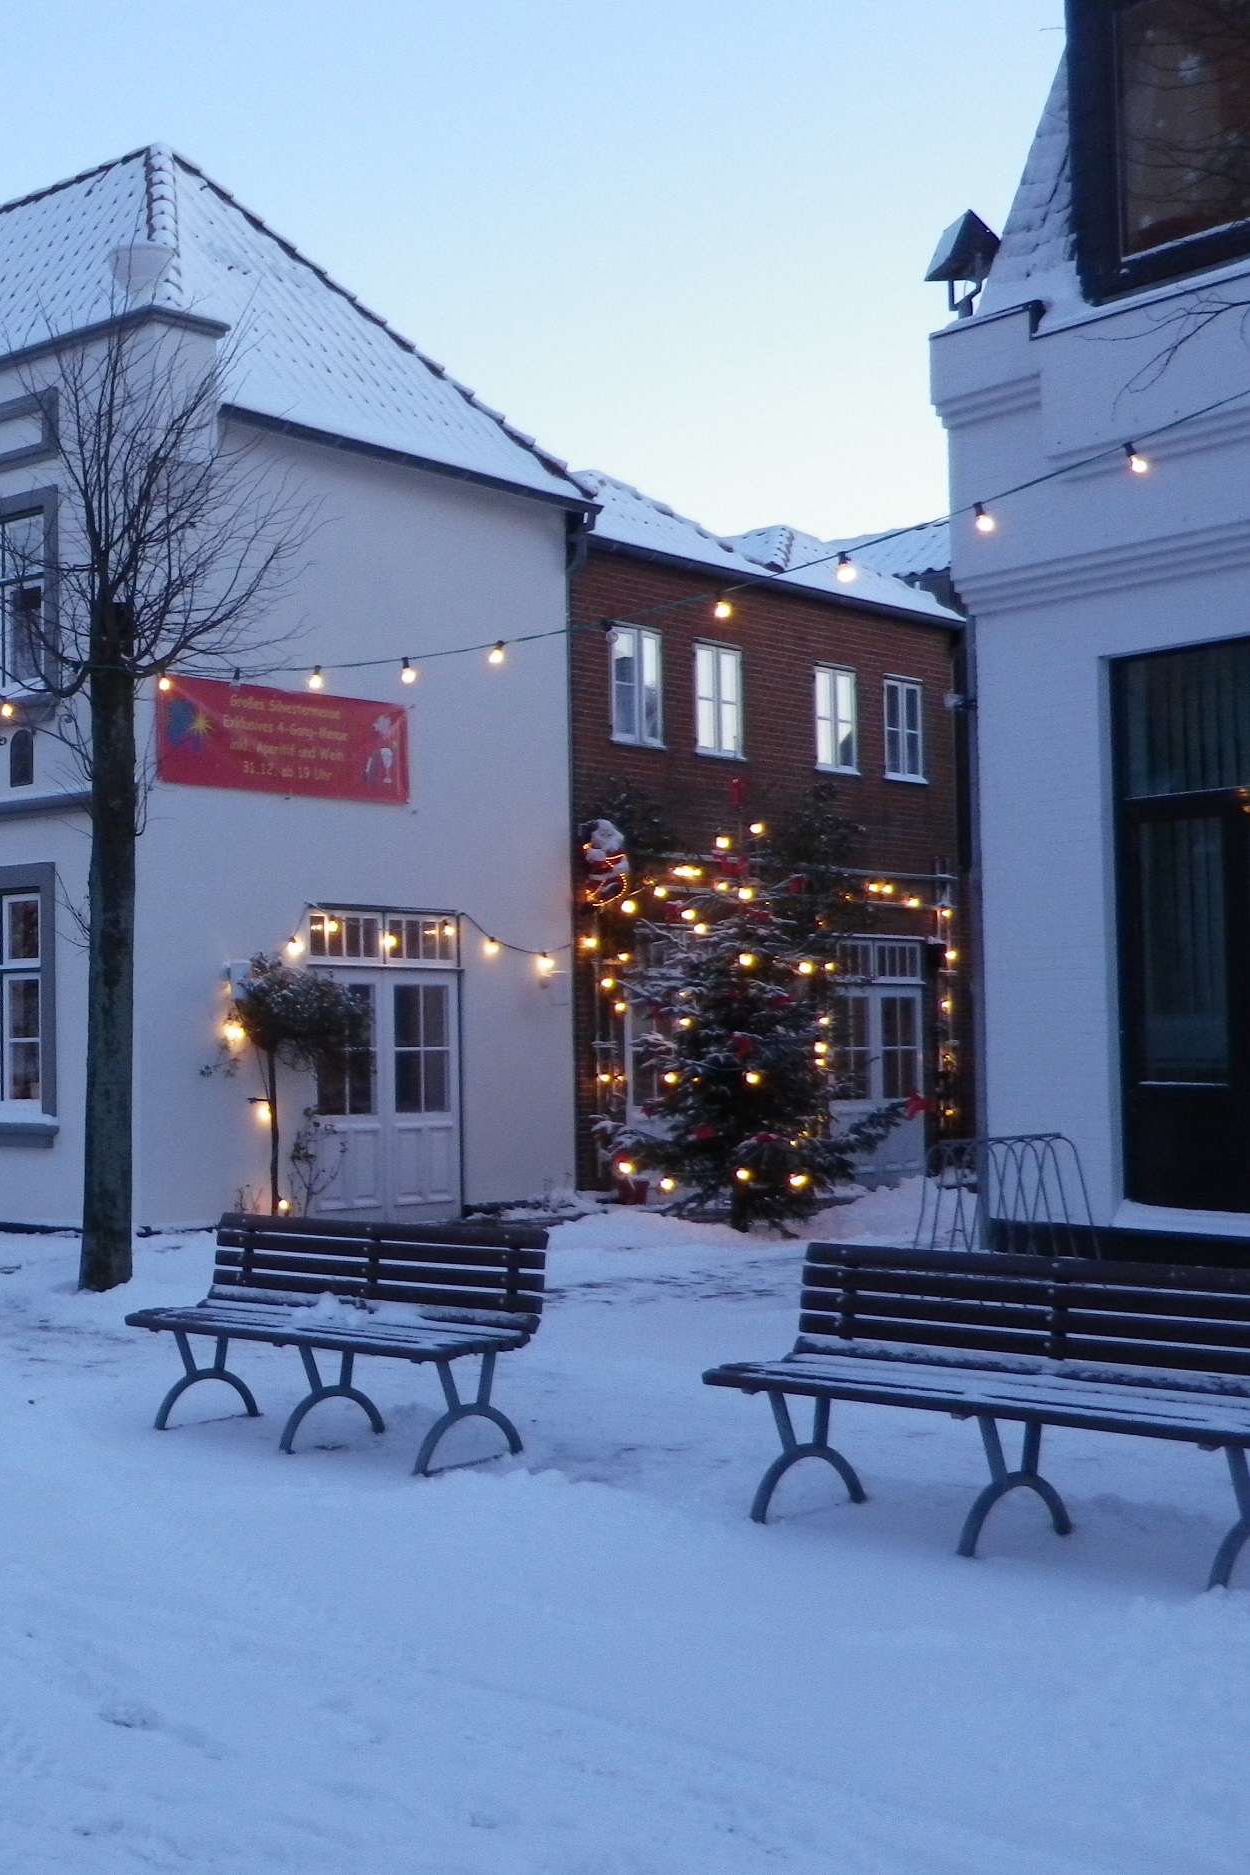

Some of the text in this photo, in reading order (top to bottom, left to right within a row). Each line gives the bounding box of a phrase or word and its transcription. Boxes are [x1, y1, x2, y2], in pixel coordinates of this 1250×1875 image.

[230, 694, 265, 711] Großes
[223, 713, 274, 733] Exklusives
[256, 742, 296, 758] Aperitif
[298, 746, 317, 759] und
[318, 746, 346, 762] Wein
[242, 760, 333, 781] 31.12. ab 19 Uhr
